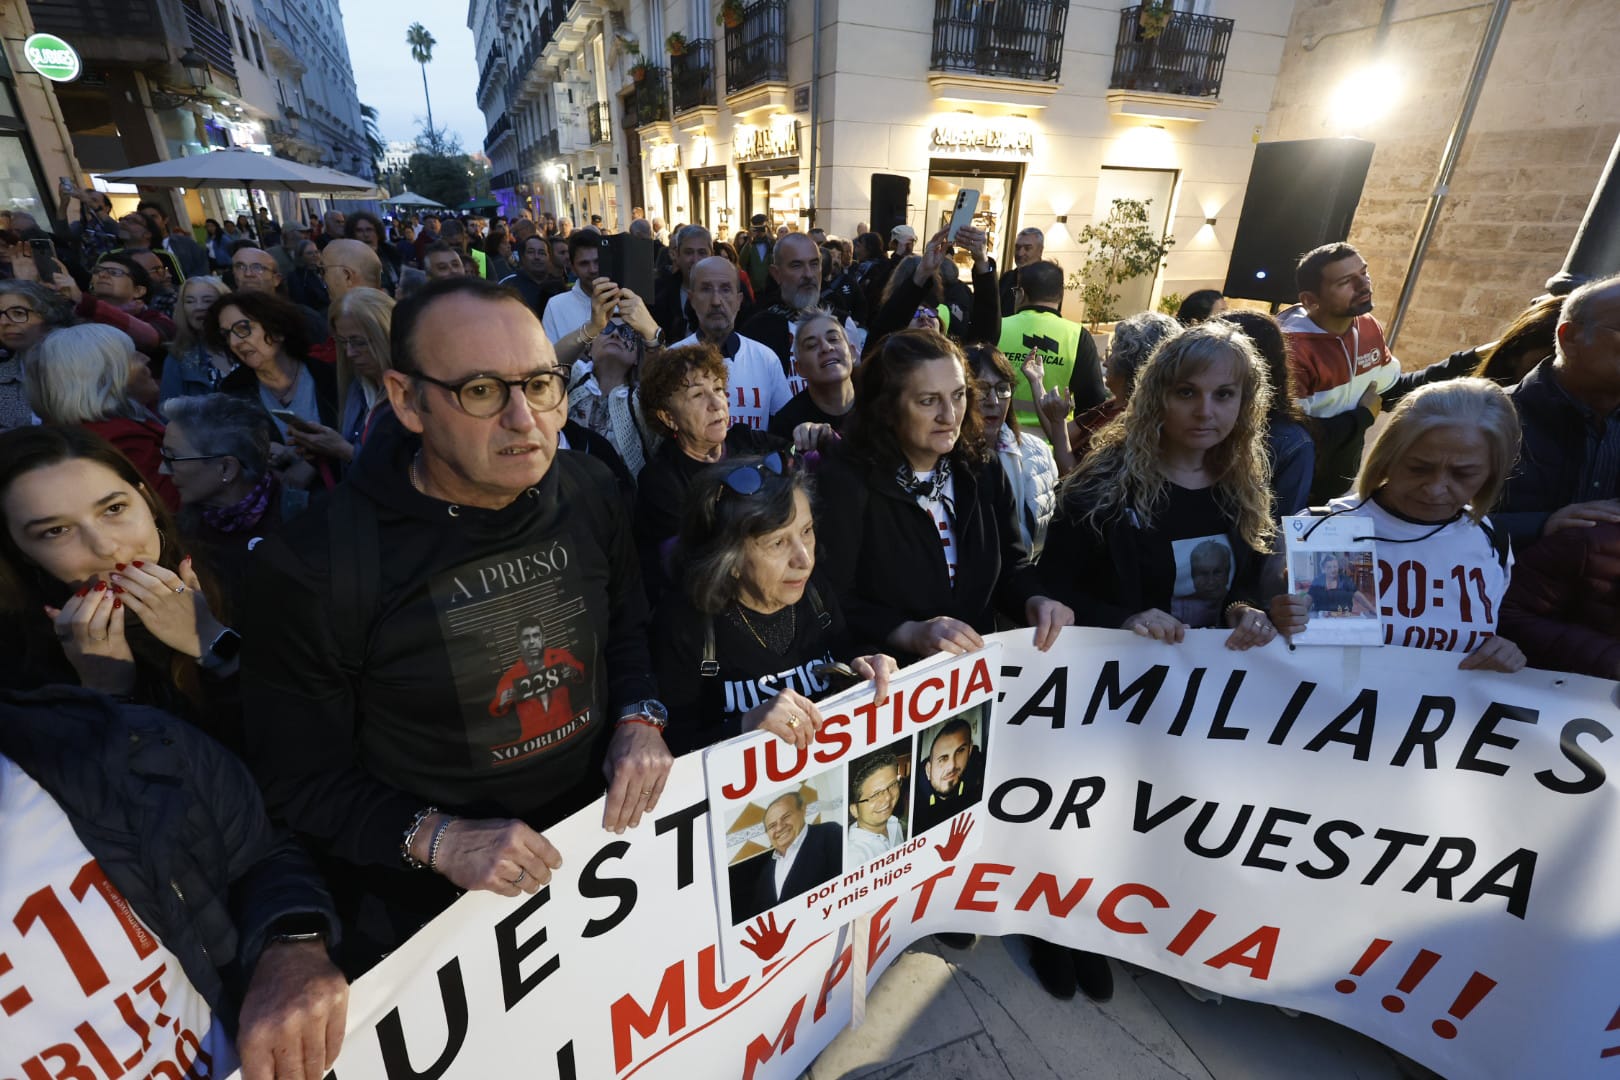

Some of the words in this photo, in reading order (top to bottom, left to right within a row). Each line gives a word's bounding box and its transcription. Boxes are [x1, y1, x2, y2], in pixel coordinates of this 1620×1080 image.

[450, 576, 473, 603] A
[478, 541, 568, 594] PRESÓ
[1378, 559, 1494, 624] 20:11
[520, 668, 559, 698] 228
[724, 650, 835, 713] JUSTIC
[491, 747, 519, 763] NO
[523, 711, 590, 753] OBLIDEM
[722, 657, 994, 801] JUSTICIA
[807, 881, 839, 908] por
[843, 866, 865, 887] mi
[870, 836, 927, 873] marido
[987, 775, 1106, 830] OR
[1132, 779, 1538, 921] VUESTRA
[822, 904, 833, 920] y
[838, 886, 868, 909] mis
[873, 862, 912, 890] hijos
[322, 799, 709, 1080] UEST
[1334, 938, 1498, 1041] !!!
